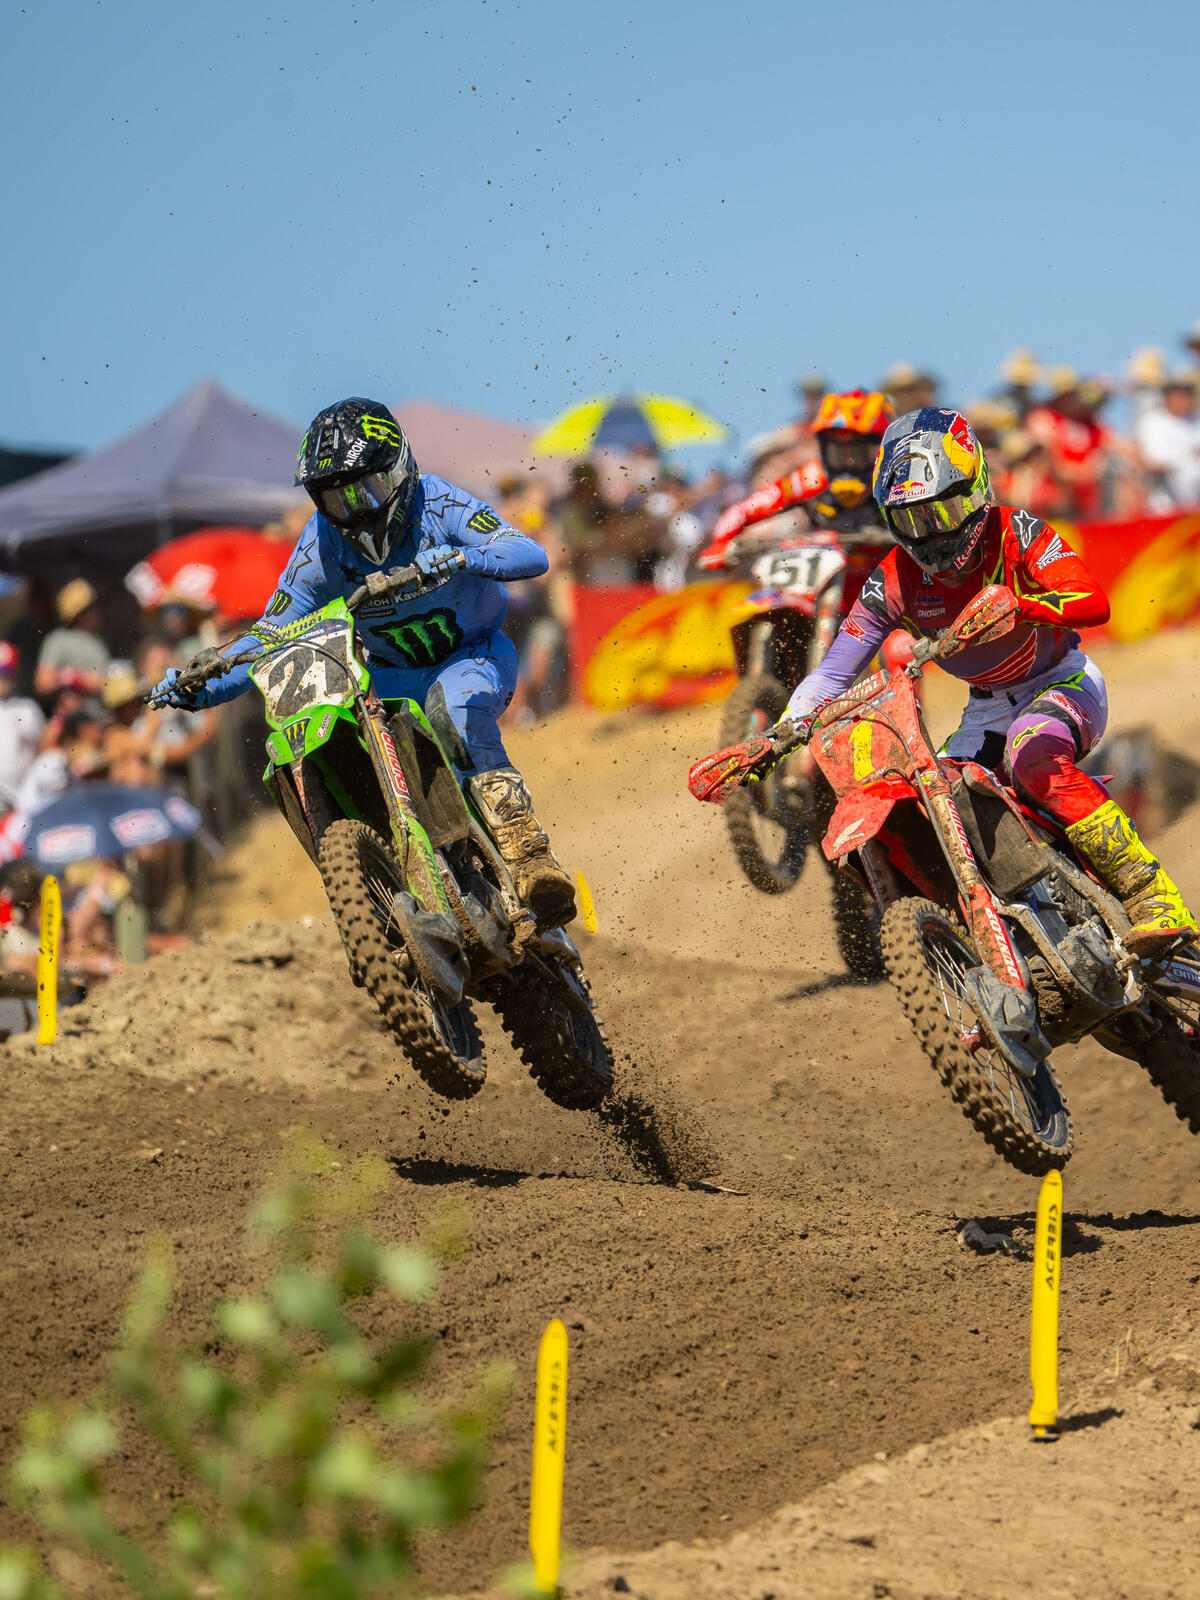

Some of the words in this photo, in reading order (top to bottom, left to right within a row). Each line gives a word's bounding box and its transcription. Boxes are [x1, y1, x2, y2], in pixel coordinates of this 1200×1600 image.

[768, 553, 818, 589] 51
[953, 532, 978, 570] Red
[1038, 550, 1077, 570] HONDA
[916, 607, 946, 618] SHOWA
[268, 635, 349, 716] 21
[848, 711, 877, 783] 1
[985, 907, 1020, 981] DUNLOP
[1045, 1203, 1058, 1291] ACERBIS
